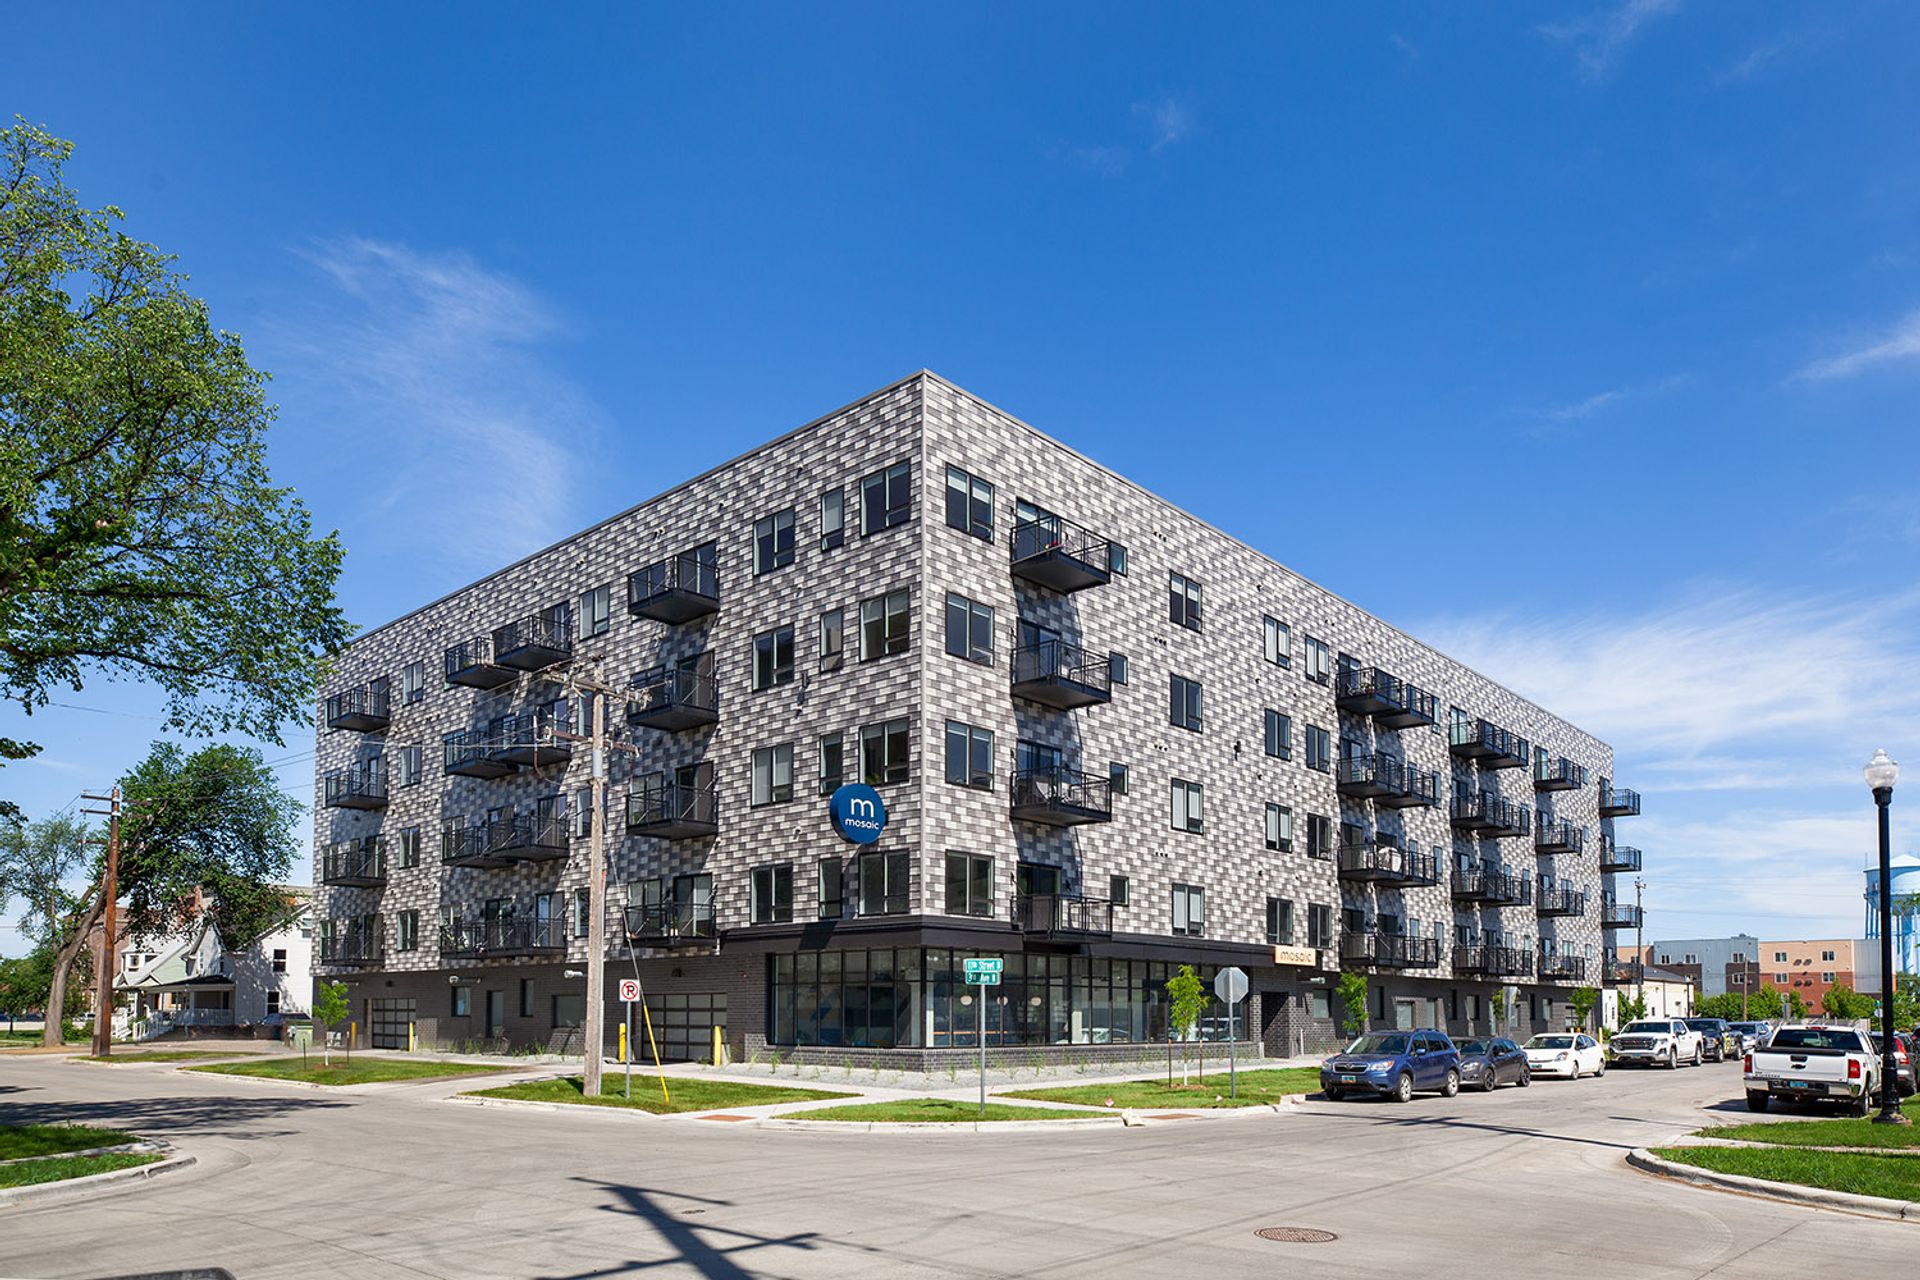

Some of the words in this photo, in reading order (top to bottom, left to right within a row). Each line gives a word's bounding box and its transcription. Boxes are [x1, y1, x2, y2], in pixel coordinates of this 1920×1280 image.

[850, 798, 875, 818] m
[844, 818, 880, 830] mosaic
[1280, 951, 1312, 963] mosaic
